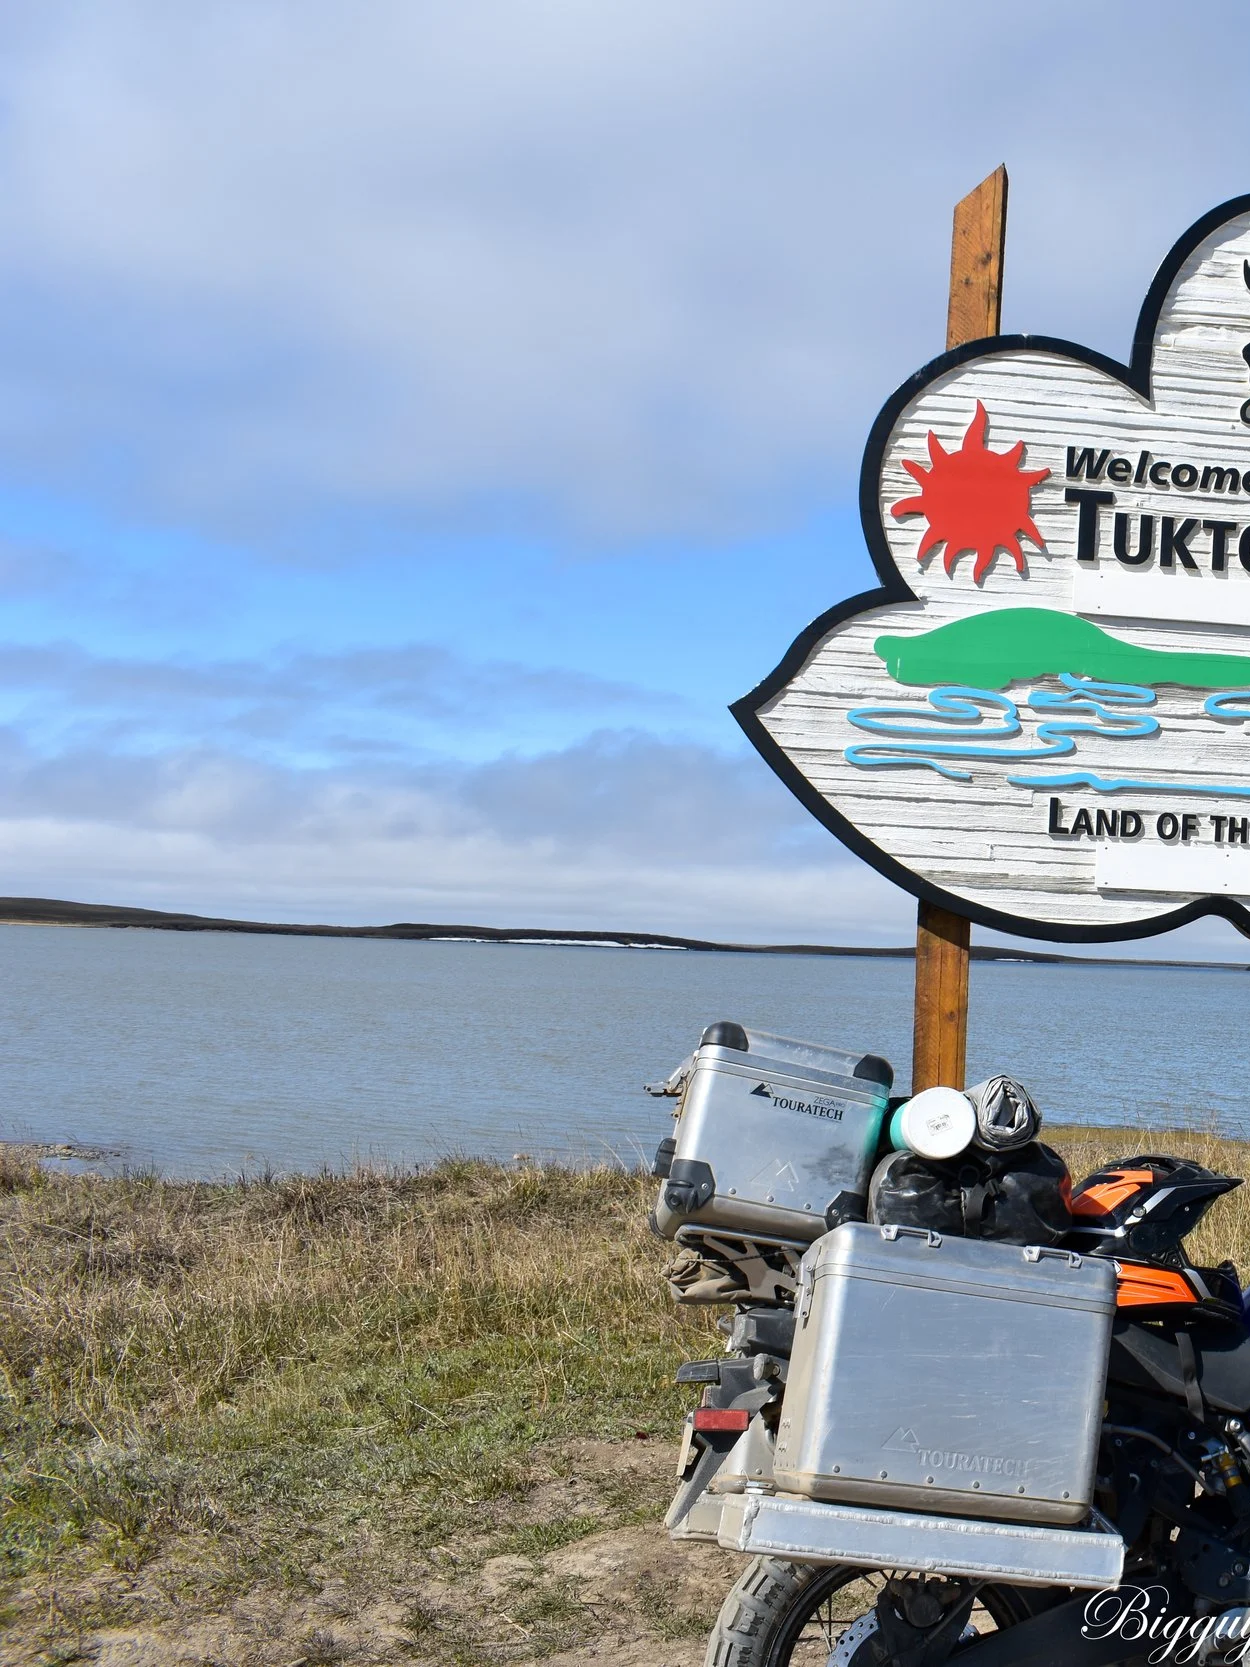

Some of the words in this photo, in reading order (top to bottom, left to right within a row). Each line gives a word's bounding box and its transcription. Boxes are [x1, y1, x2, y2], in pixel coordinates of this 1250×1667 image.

[1156, 812, 1197, 841] OF
[773, 1097, 844, 1120] TOURATECH
[918, 1449, 1028, 1476] TOURATECH
